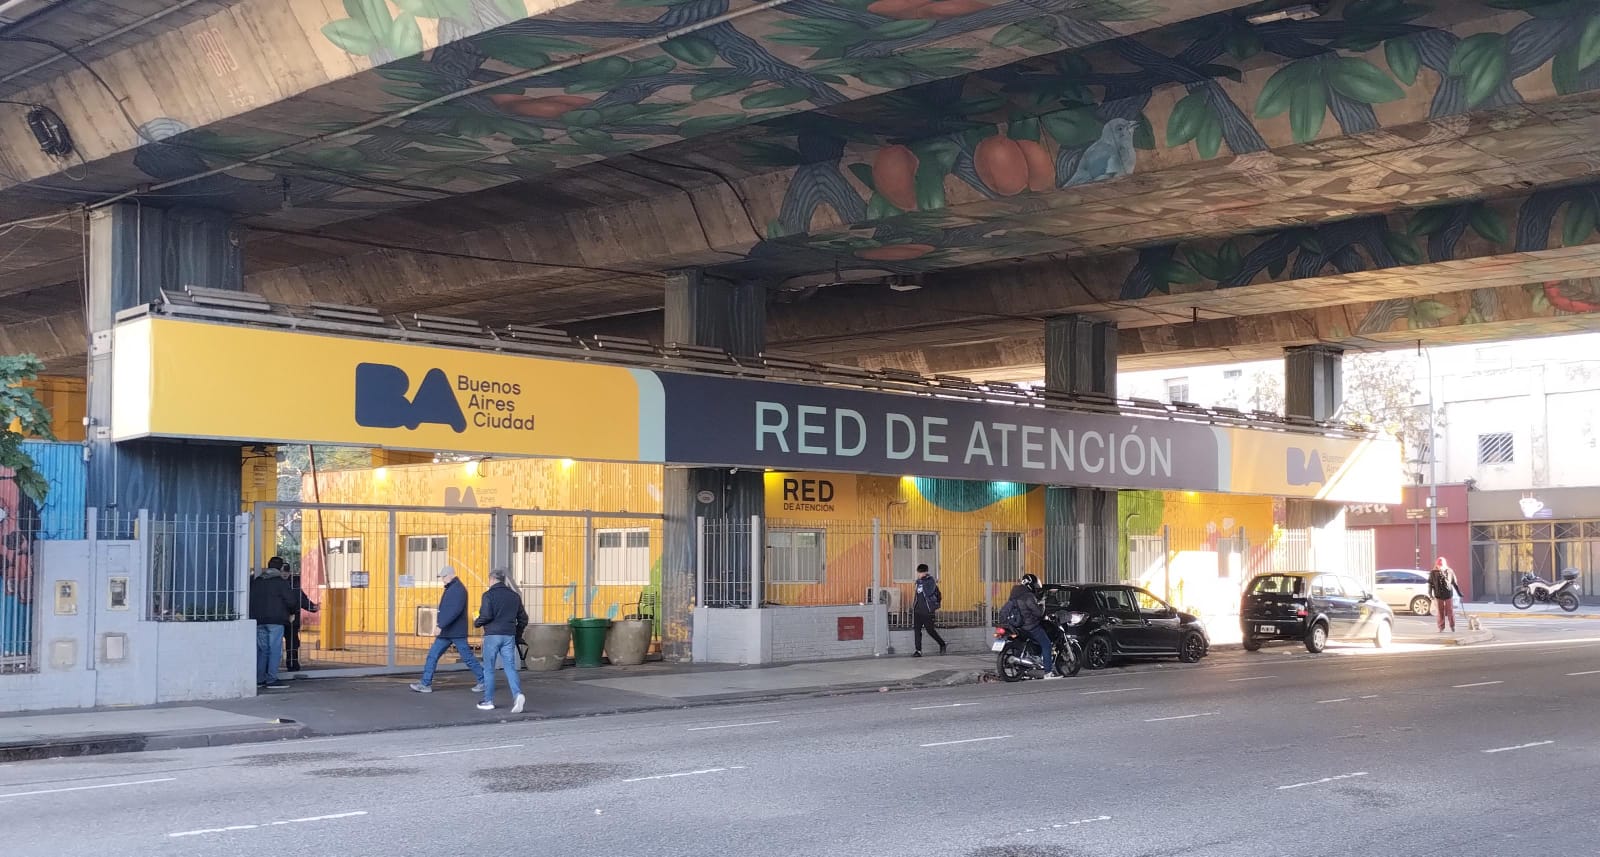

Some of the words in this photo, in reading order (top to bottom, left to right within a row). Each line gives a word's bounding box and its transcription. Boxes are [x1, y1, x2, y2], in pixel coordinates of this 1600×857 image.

[457, 375, 521, 395] Buenos
[355, 362, 467, 433] BA
[468, 394, 515, 412] Aires
[473, 412, 535, 431] Ciudad
[755, 400, 868, 457] RED
[886, 412, 950, 463] DE
[963, 420, 1173, 478] ATENCIÓN
[1286, 446, 1327, 487] BA
[783, 478, 834, 502] RED
[783, 502, 794, 511] DE
[795, 503, 835, 512] ATENCIÓN
